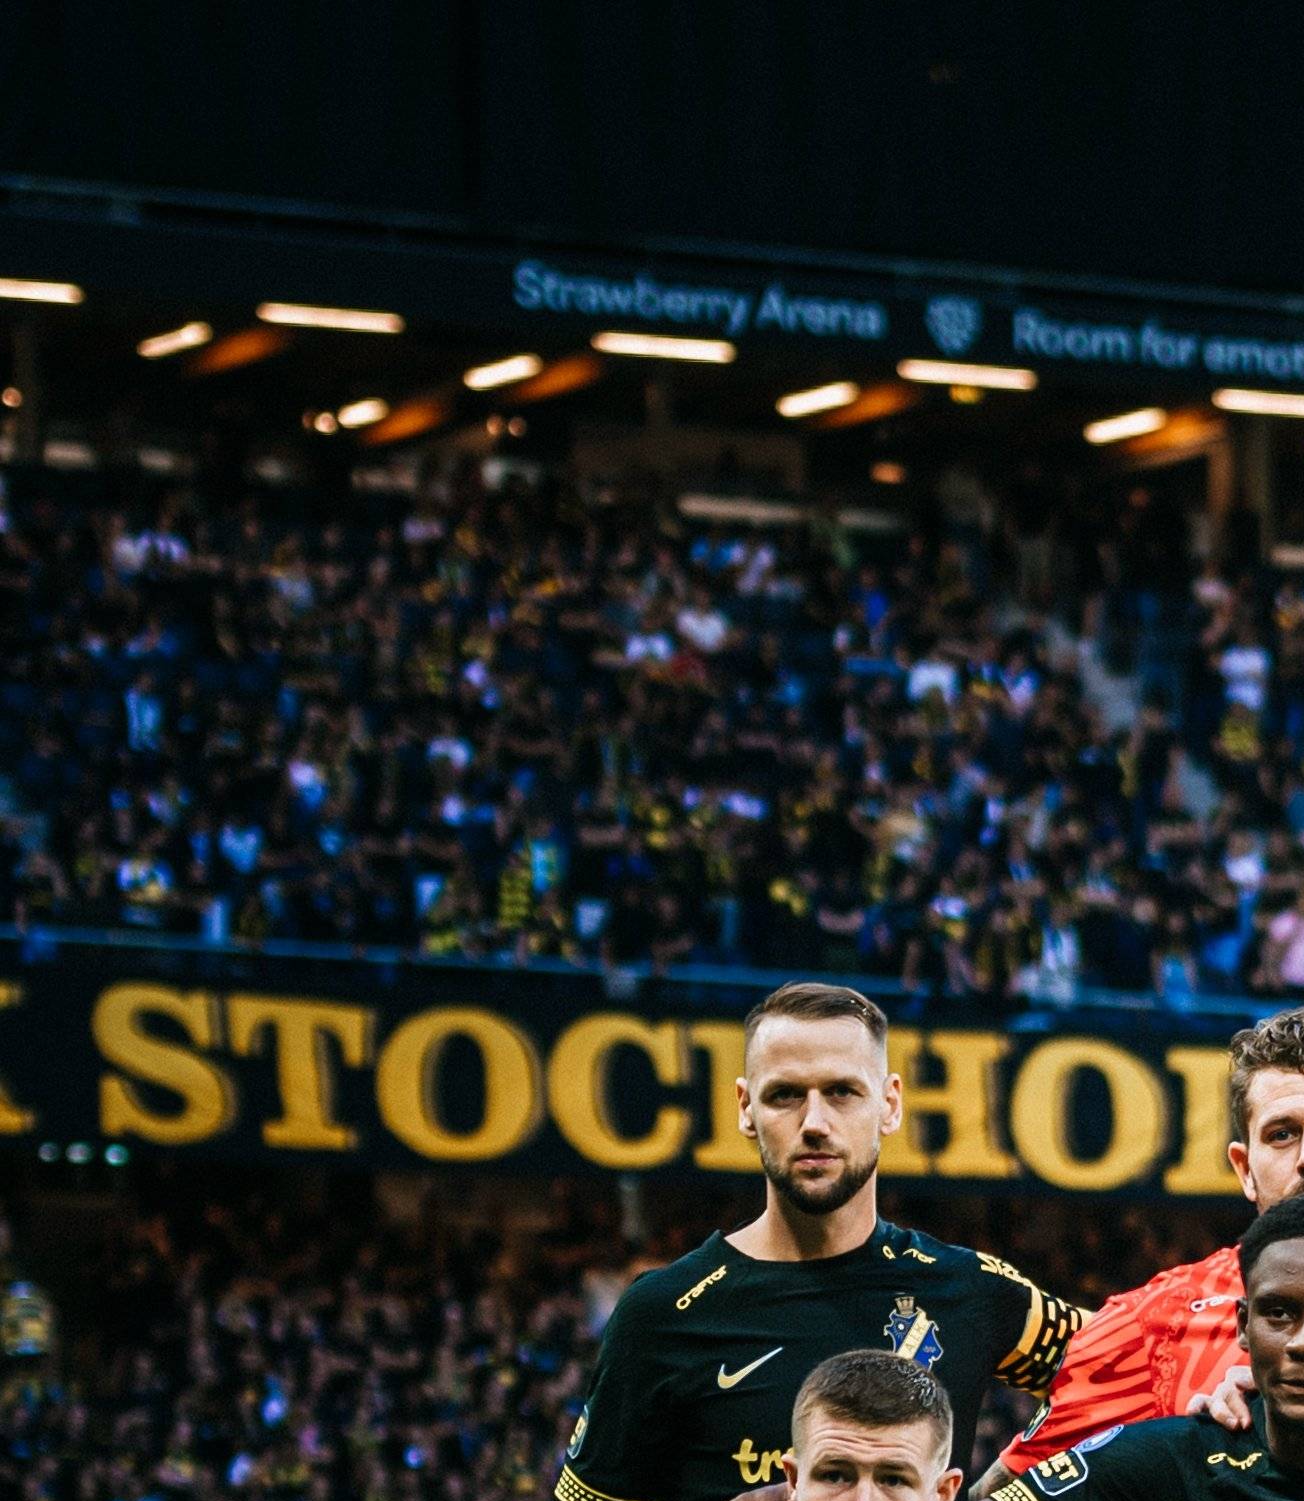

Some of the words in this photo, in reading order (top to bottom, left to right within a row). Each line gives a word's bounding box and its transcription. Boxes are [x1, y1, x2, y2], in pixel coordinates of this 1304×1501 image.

[513, 259, 749, 336] Strawberry
[755, 283, 889, 340] Arena
[1012, 309, 1135, 359] Room
[1139, 317, 1197, 366] for
